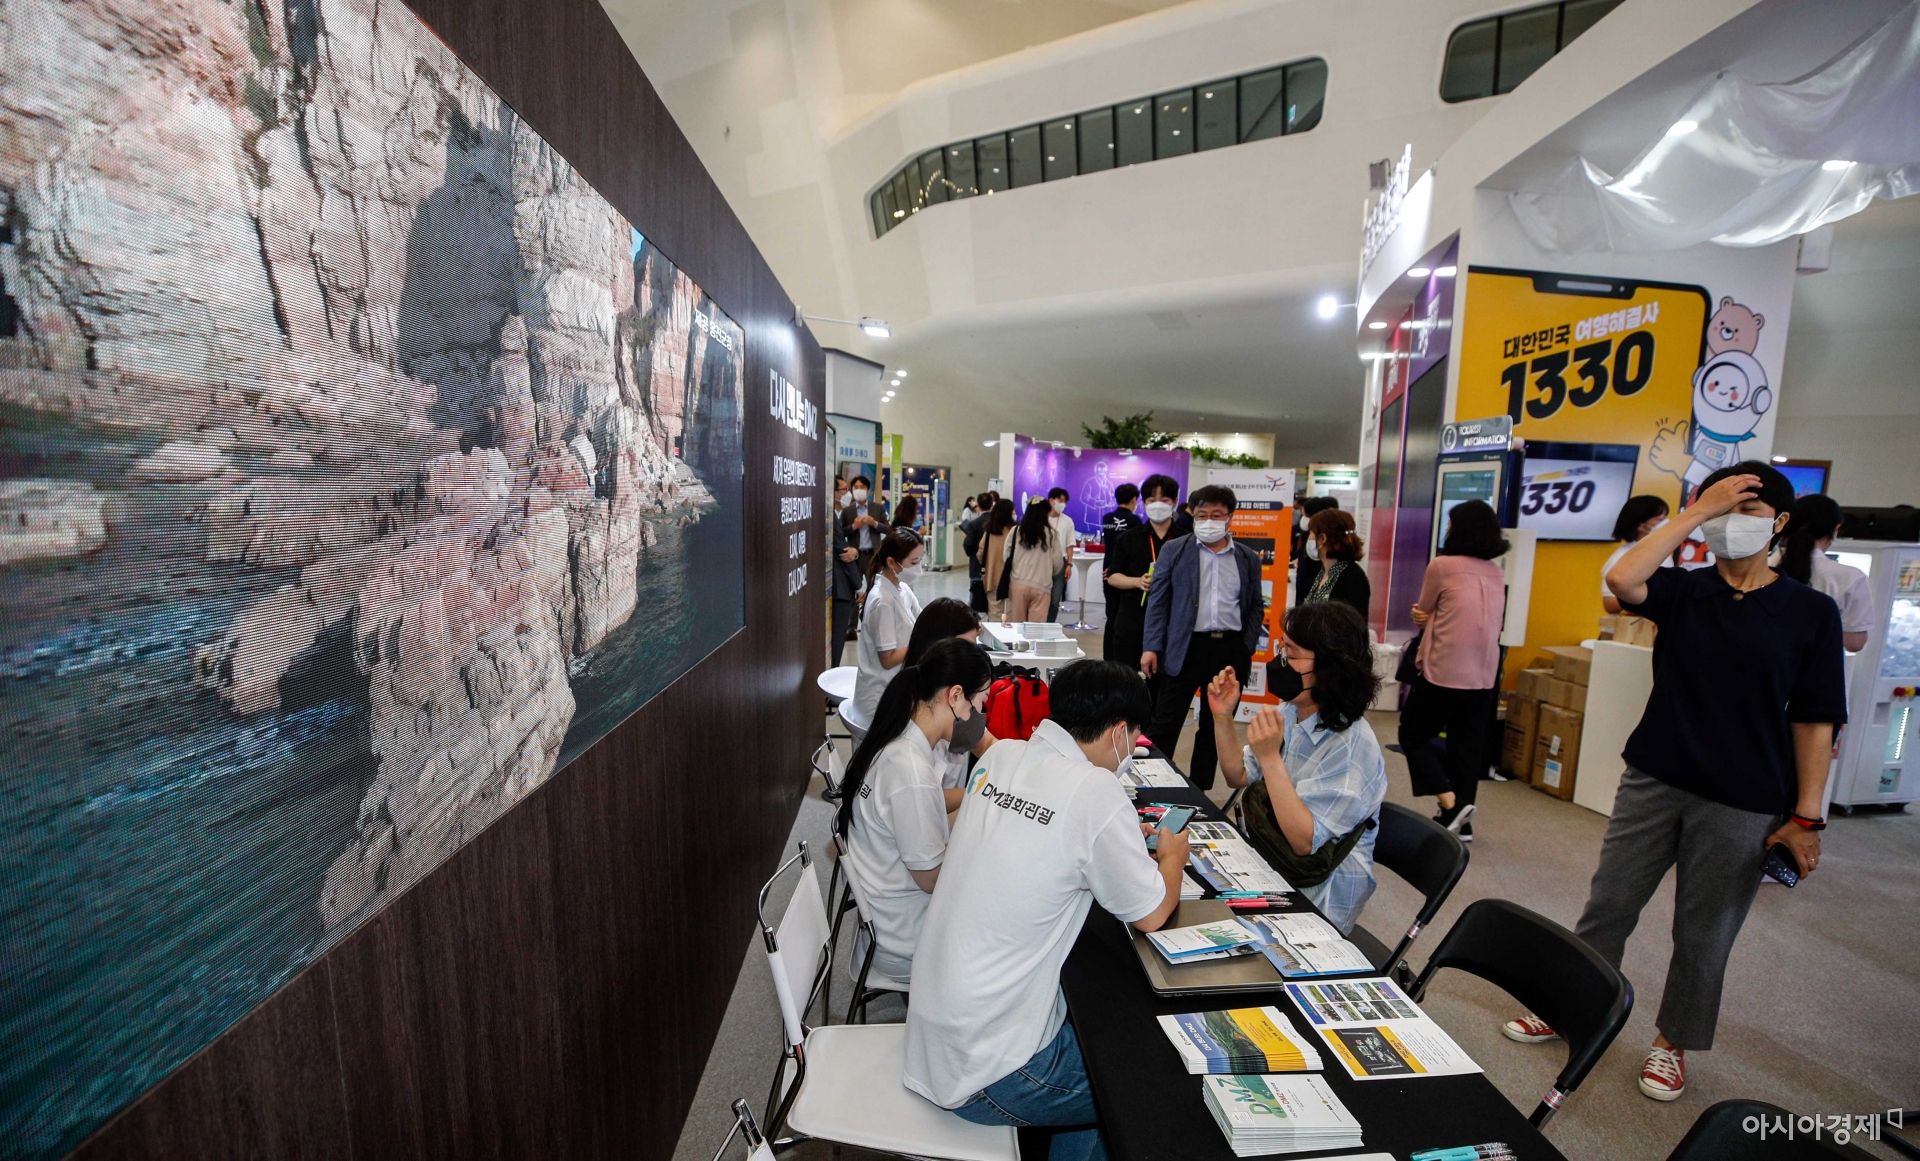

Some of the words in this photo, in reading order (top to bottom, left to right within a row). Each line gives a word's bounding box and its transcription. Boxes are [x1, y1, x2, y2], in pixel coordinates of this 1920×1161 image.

[1503, 324, 1571, 359] 대한민국
[1575, 301, 1659, 341] 여행해결사
[770, 368, 785, 424] 다시
[804, 398, 818, 440] DMZ
[1501, 331, 1655, 425] 1330
[1463, 434, 1508, 447] INFORMATION
[1216, 1077, 1273, 1115] DMZ
